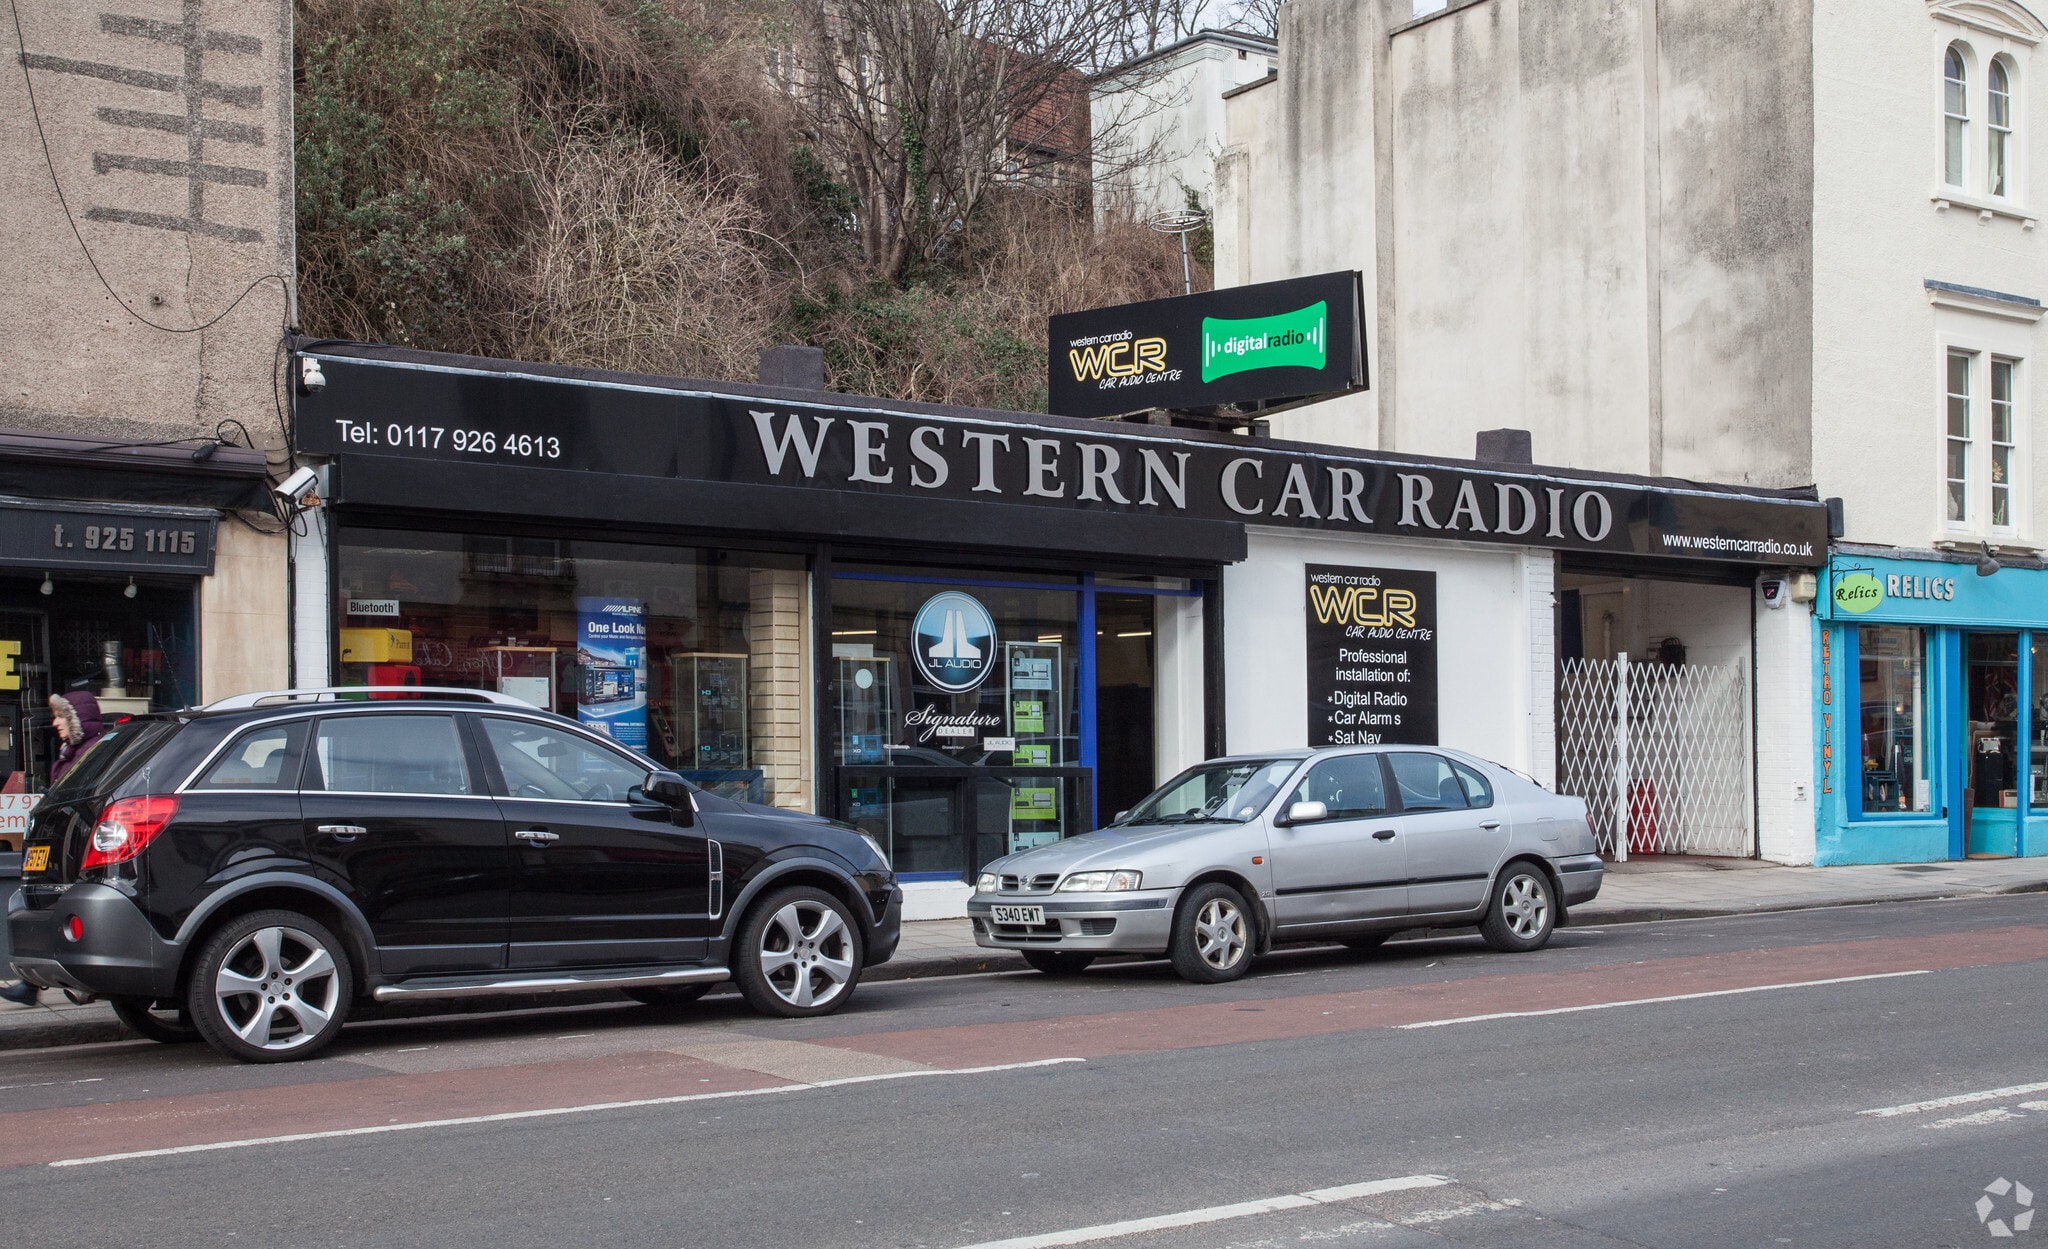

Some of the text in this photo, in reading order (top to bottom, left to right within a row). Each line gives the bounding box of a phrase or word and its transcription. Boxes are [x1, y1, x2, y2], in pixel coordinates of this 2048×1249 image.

[1069, 337, 1167, 382] WCR
[1099, 369, 1183, 390] CAR AUDIO CENTRE
[335, 419, 561, 459] Tel: 0117 926 4613
[748, 410, 1612, 542] WESTERN CAR RADIO
[85, 526, 134, 551] 925
[145, 529, 195, 554] 1115
[1662, 534, 1813, 556] www.westerncarradio.co.uk
[1310, 573, 1343, 584] western
[1835, 585, 1879, 601] Relics
[1886, 574, 1955, 601] RELICS
[350, 602, 394, 612] Bluetooth
[616, 605, 642, 614] ALPINE
[1309, 584, 1417, 628] WCR
[588, 621, 609, 633] One
[612, 622, 635, 634] Look
[1345, 625, 1432, 641] CAR AUDIO CENTRE
[929, 659, 982, 669] JL AUDIO
[1339, 648, 1407, 664] Professional
[1335, 667, 1411, 682] installation of:
[1334, 690, 1407, 708] Digital Radio
[1334, 710, 1401, 725] Car Alarms
[1822, 630, 1832, 794] RETRO VINYL
[904, 703, 1000, 743] Signature
[1334, 730, 1382, 744] Sat Nav
[995, 907, 1040, 922] S340 EWT
